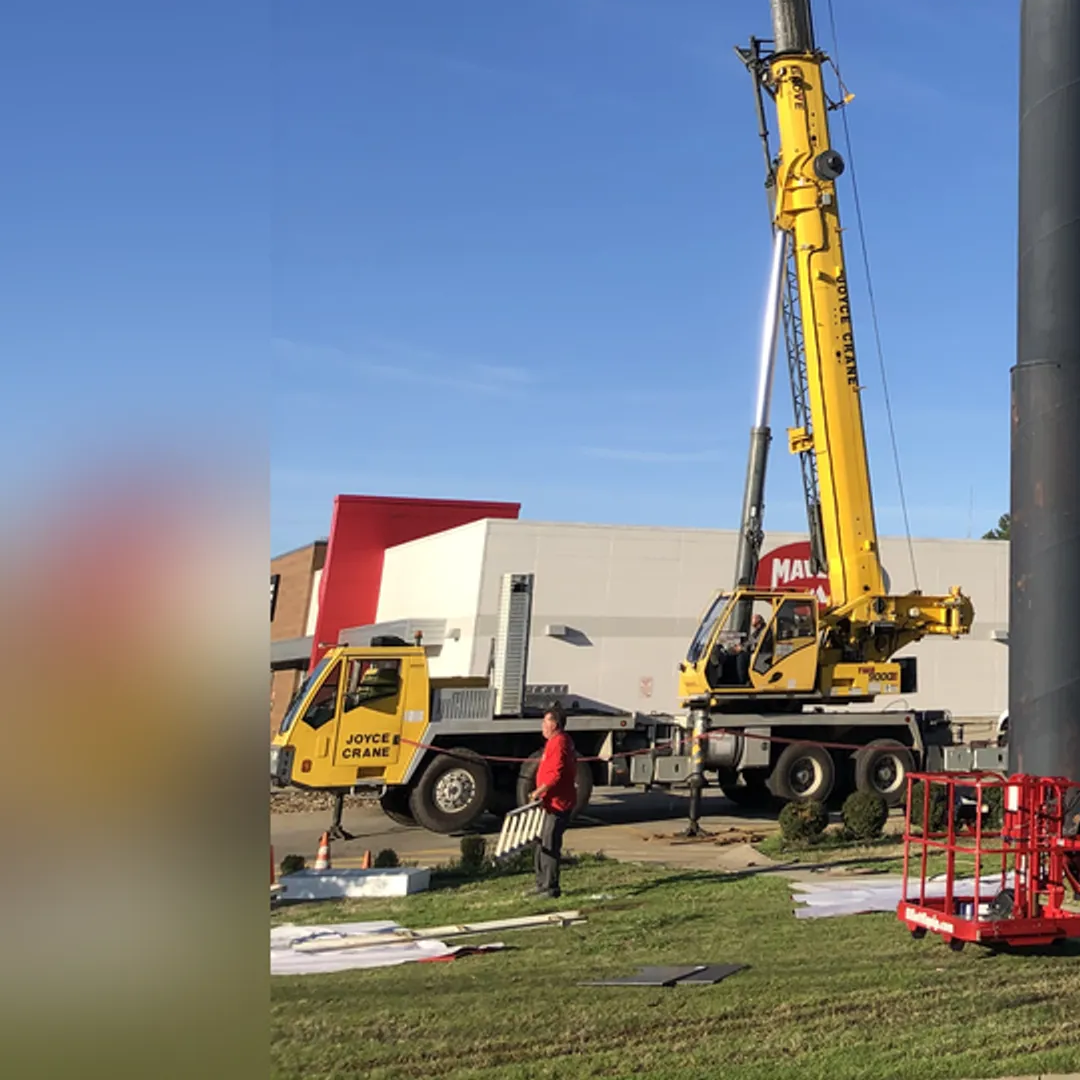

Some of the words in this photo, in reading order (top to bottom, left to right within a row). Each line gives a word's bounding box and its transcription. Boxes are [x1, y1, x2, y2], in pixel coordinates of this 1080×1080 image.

[842, 331, 858, 386] CRANE
[346, 732, 391, 745] JOYCE
[342, 747, 391, 759] CRANE
